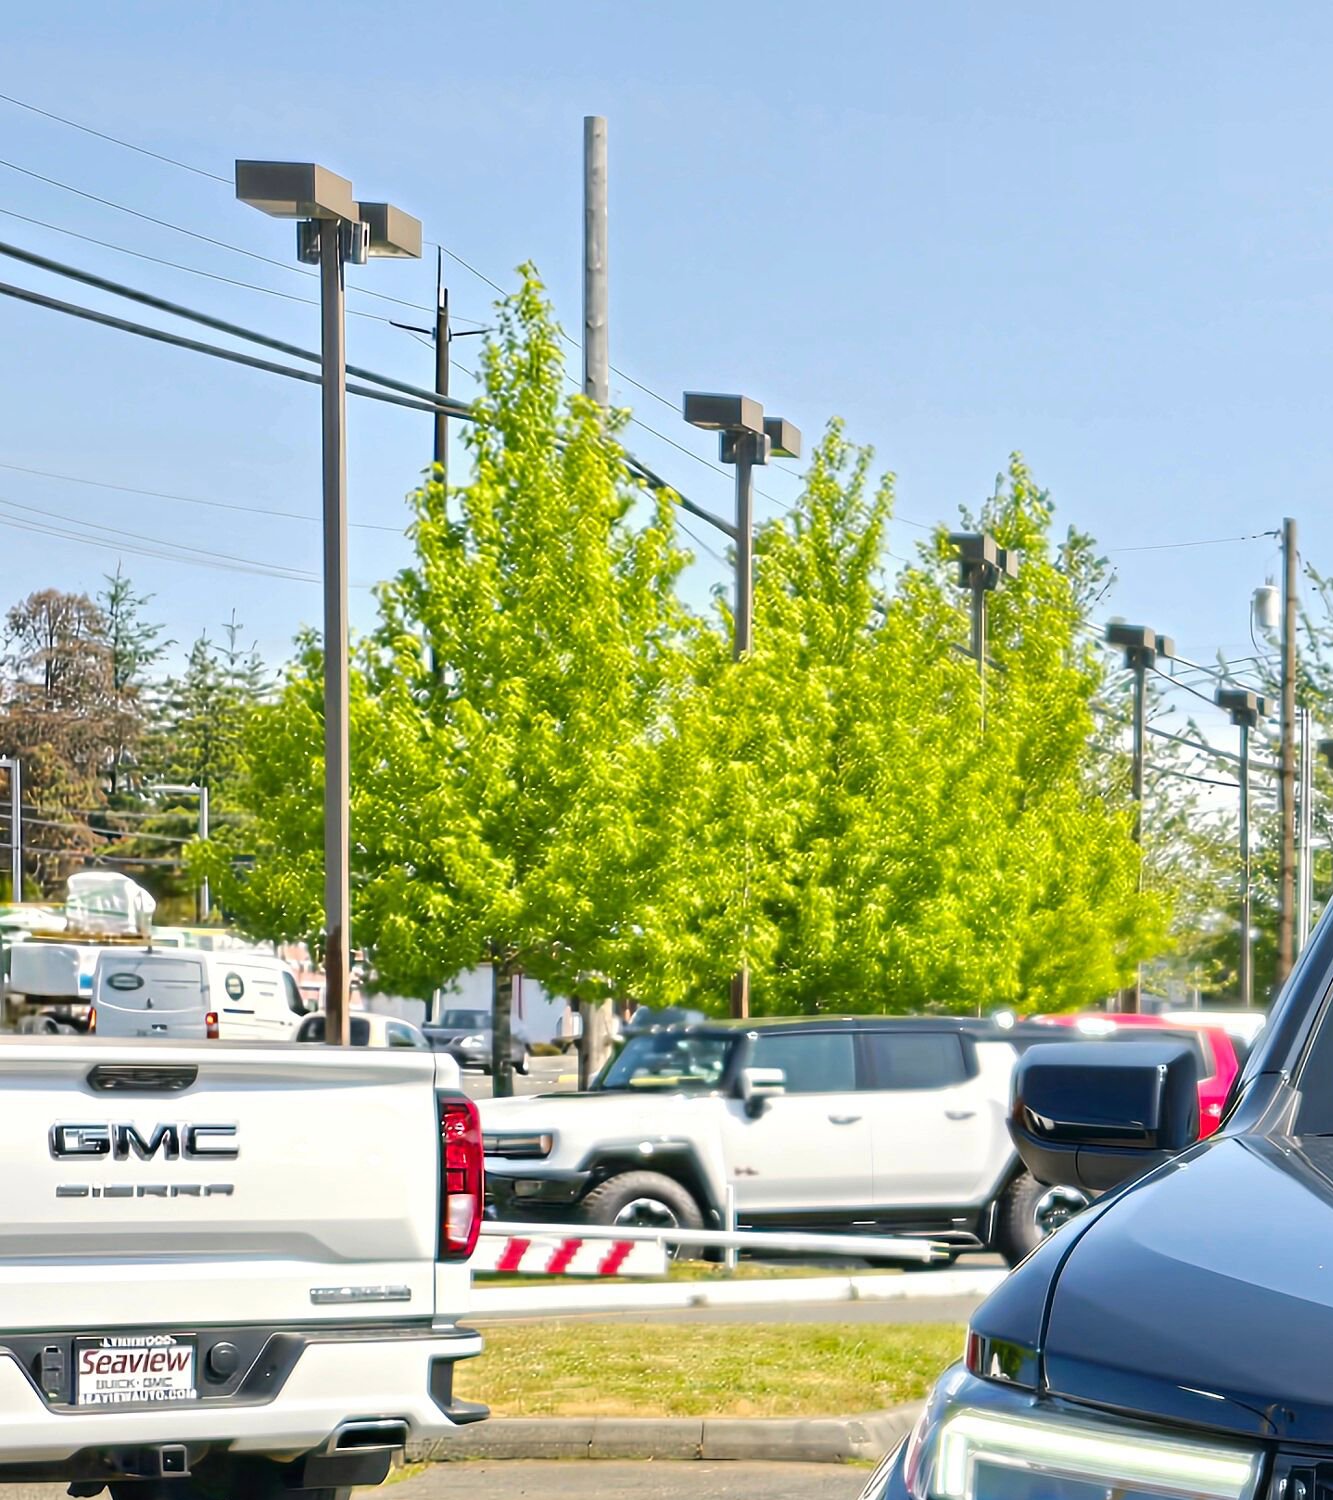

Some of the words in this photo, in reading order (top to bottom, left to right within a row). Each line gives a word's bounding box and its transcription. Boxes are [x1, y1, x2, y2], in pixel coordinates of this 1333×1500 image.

[48, 1119, 240, 1162] GMC
[80, 1350, 191, 1375] Seaview
[96, 1379, 135, 1390] BUICK
[143, 1377, 173, 1388] GMC
